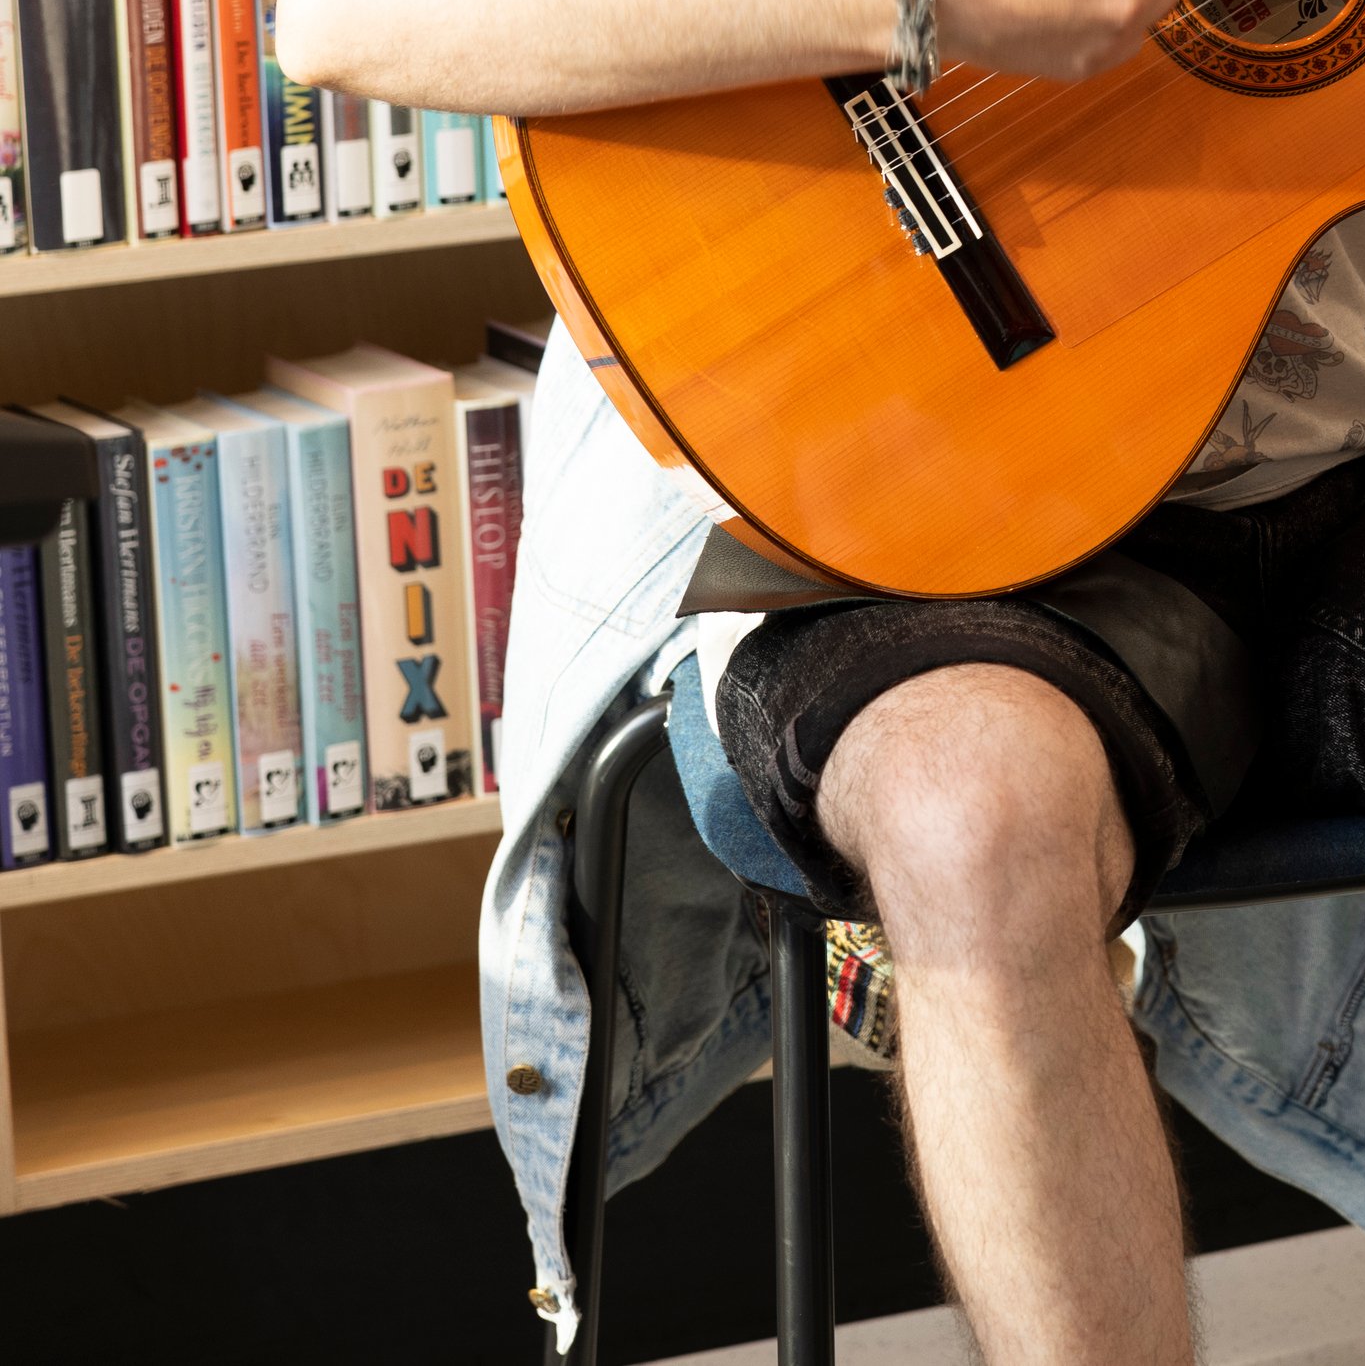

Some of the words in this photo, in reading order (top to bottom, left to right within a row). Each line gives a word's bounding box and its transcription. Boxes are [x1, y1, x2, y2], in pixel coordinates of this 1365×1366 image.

[236, 40, 252, 67] De
[109, 454, 138, 524] Stefan
[383, 461, 438, 498] DE
[469, 442, 508, 570] HISLOP
[307, 450, 333, 583] HILDERBRAND
[56, 518, 81, 628] Hertmans
[115, 529, 143, 635] Hertmans
[338, 602, 357, 643] Een
[387, 505, 450, 723] NIX
[64, 634, 83, 663] De
[124, 637, 146, 677] DE
[317, 672, 335, 704] zee
